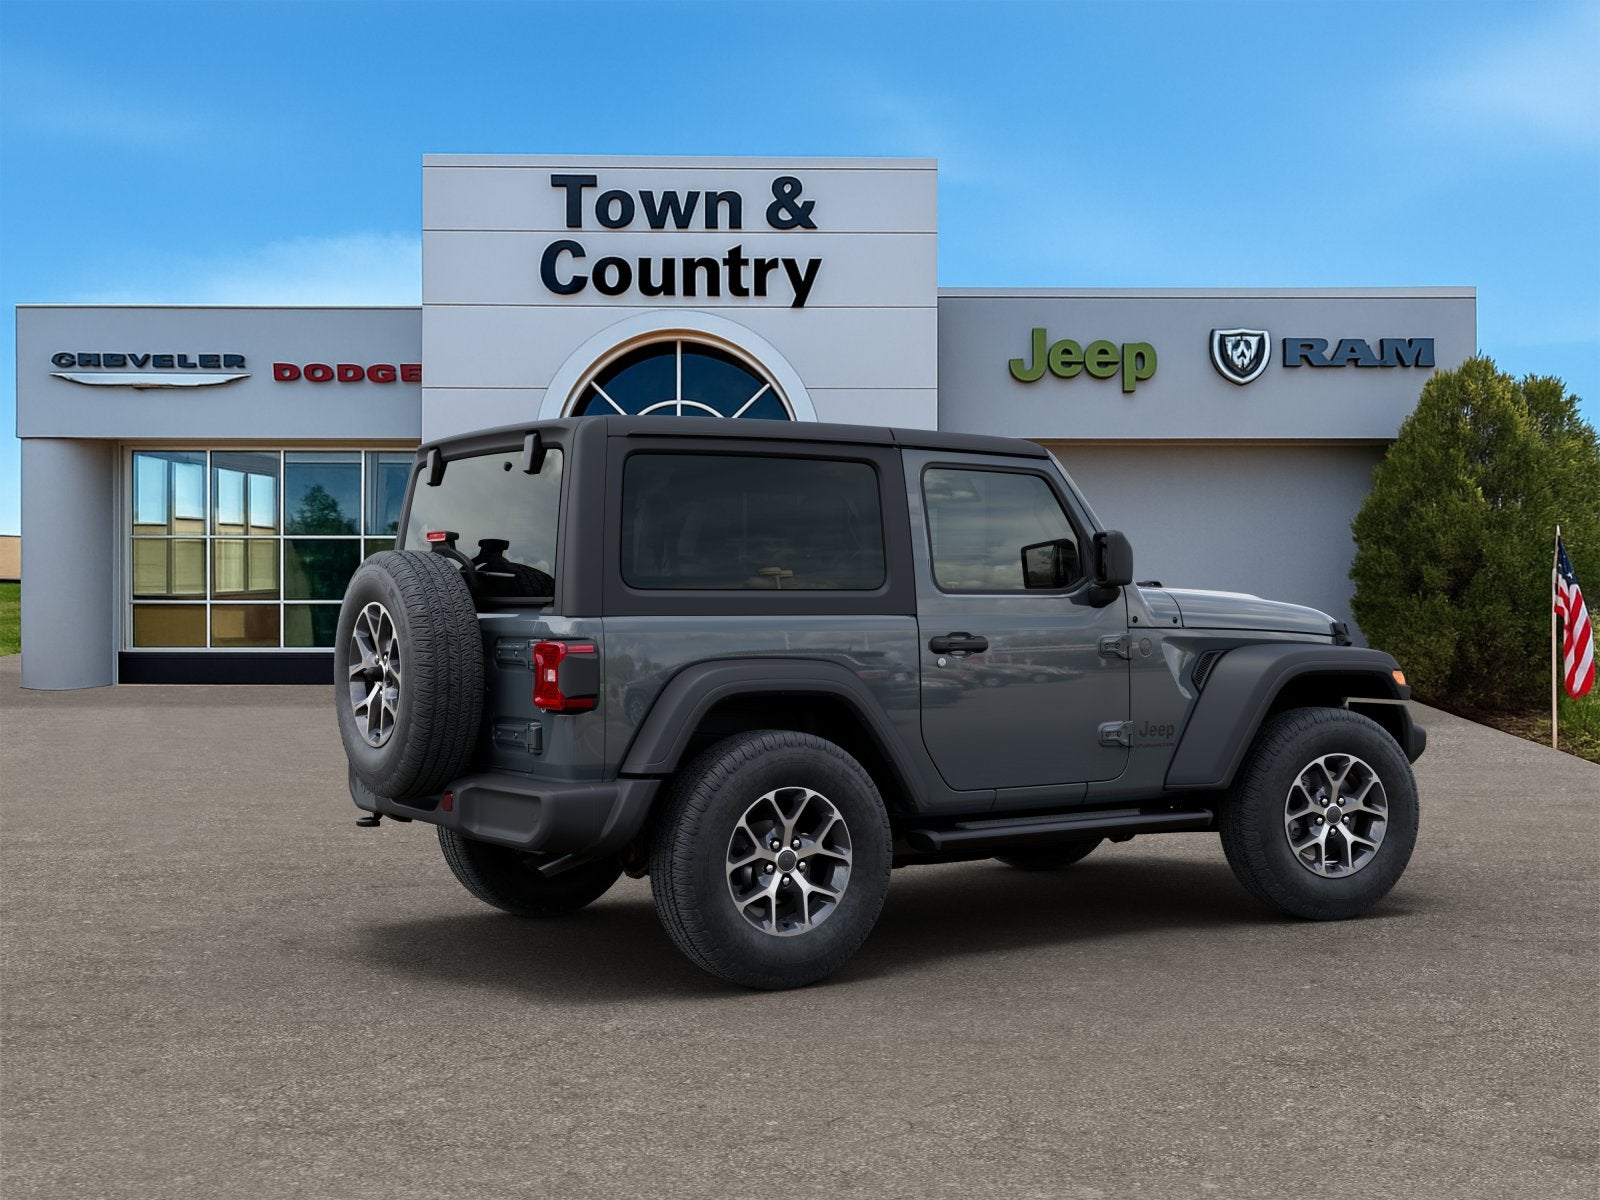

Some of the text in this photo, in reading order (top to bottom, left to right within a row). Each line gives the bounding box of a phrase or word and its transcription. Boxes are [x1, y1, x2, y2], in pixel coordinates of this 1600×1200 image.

[550, 174, 818, 231] Town &
[540, 239, 822, 309] Country
[273, 362, 422, 384] DODGE
[1009, 328, 1158, 393] Jeep
[1282, 337, 1436, 368] RAM
[1139, 721, 1175, 739] Jeep
